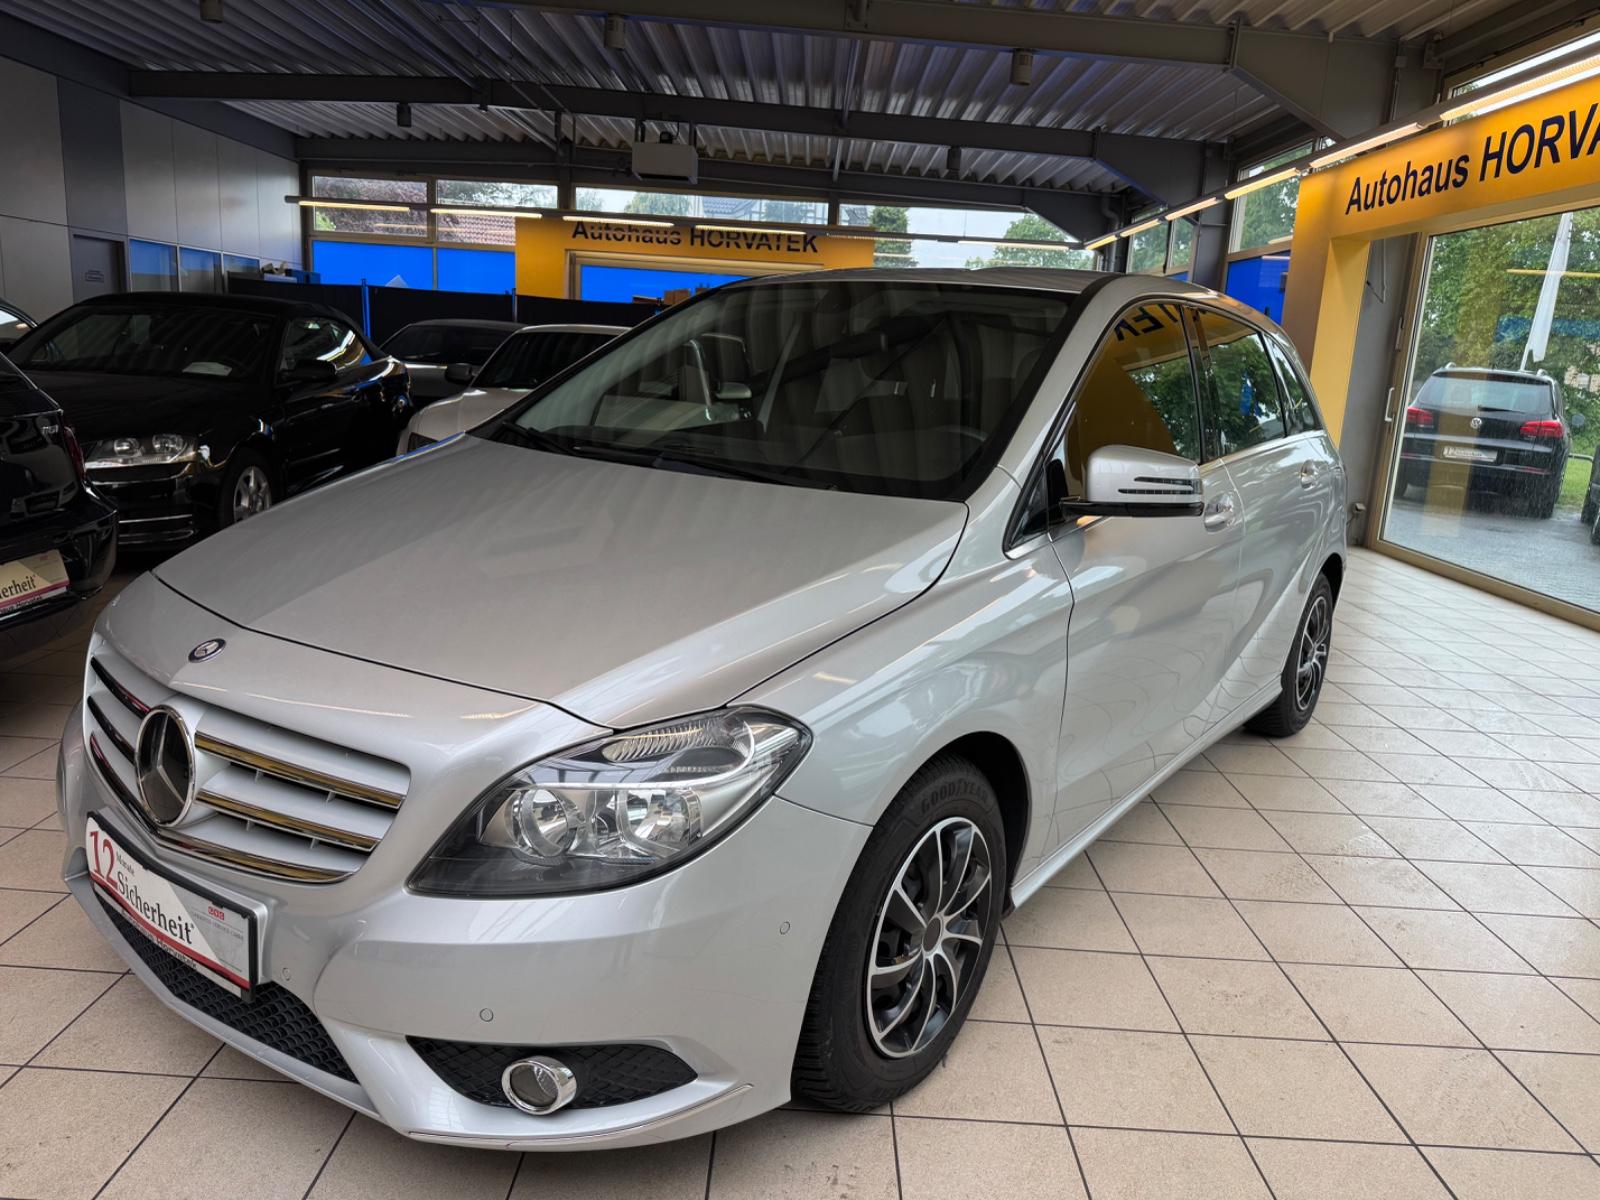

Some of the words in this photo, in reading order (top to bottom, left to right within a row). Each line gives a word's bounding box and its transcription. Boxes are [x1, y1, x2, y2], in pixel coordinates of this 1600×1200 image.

[1345, 154, 1470, 216] Autohaus
[572, 220, 682, 246] Autohaus
[689, 227, 818, 253] HORVATEK
[921, 777, 989, 814] GOODYEAR
[89, 830, 119, 890] 12
[116, 871, 193, 945] Sicherheit
